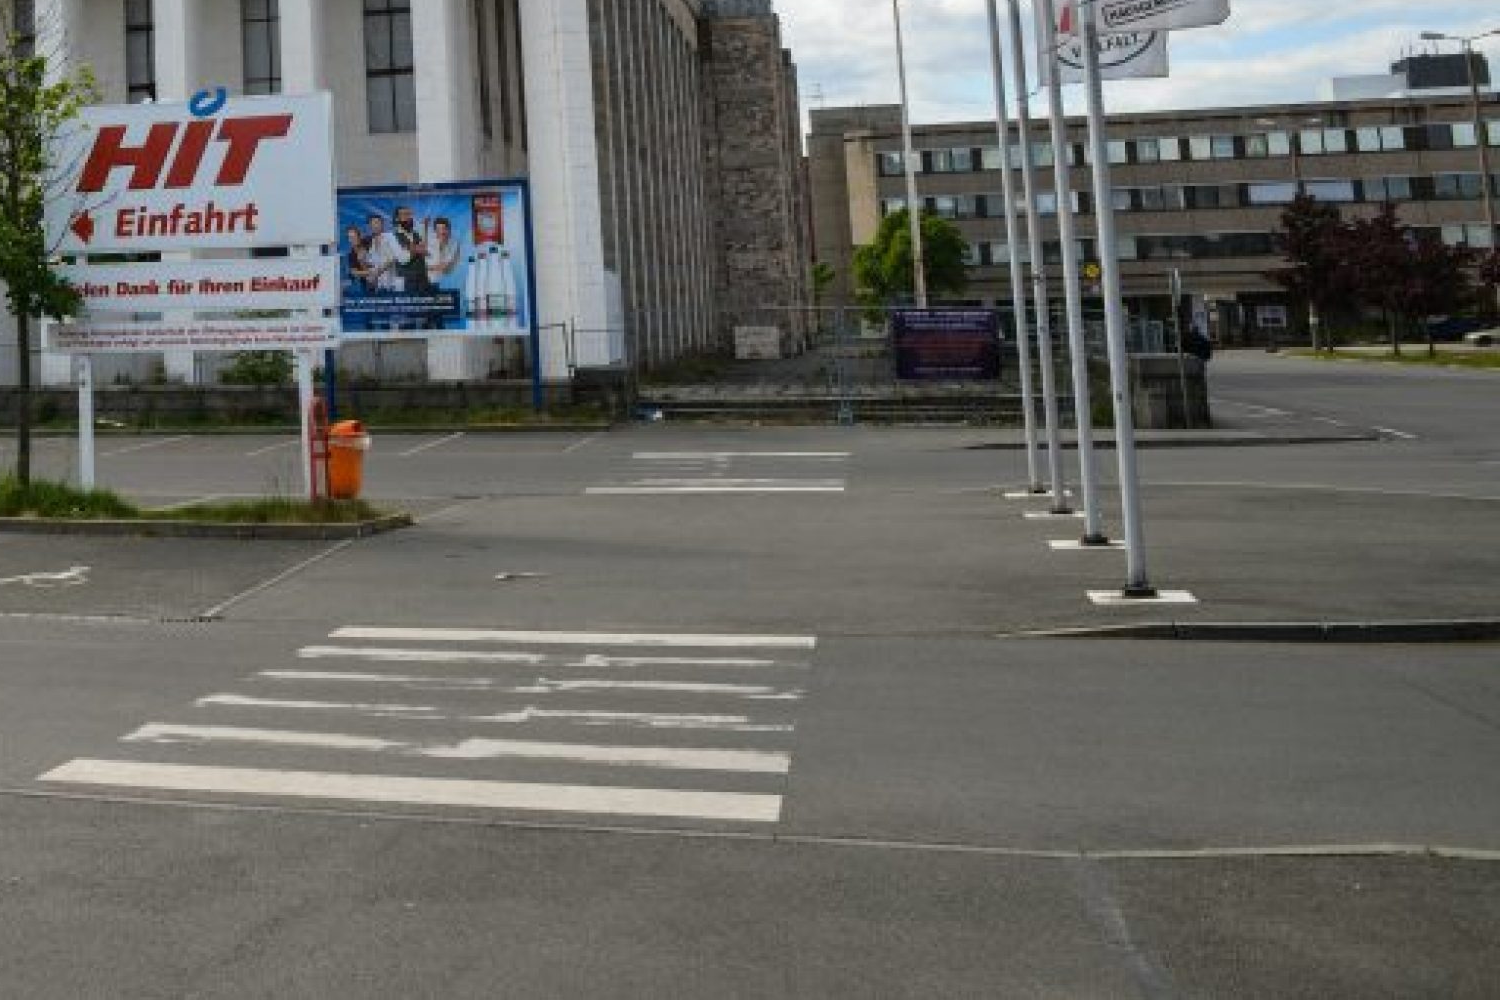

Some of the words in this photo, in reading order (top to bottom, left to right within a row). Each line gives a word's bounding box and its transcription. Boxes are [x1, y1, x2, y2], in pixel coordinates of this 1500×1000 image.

[76, 89, 294, 192] HIT
[115, 201, 258, 237] Einfahrt
[116, 279, 160, 295] Dank
[167, 278, 194, 295] für
[199, 278, 244, 294] Ihren
[251, 273, 320, 293] Einkauf
